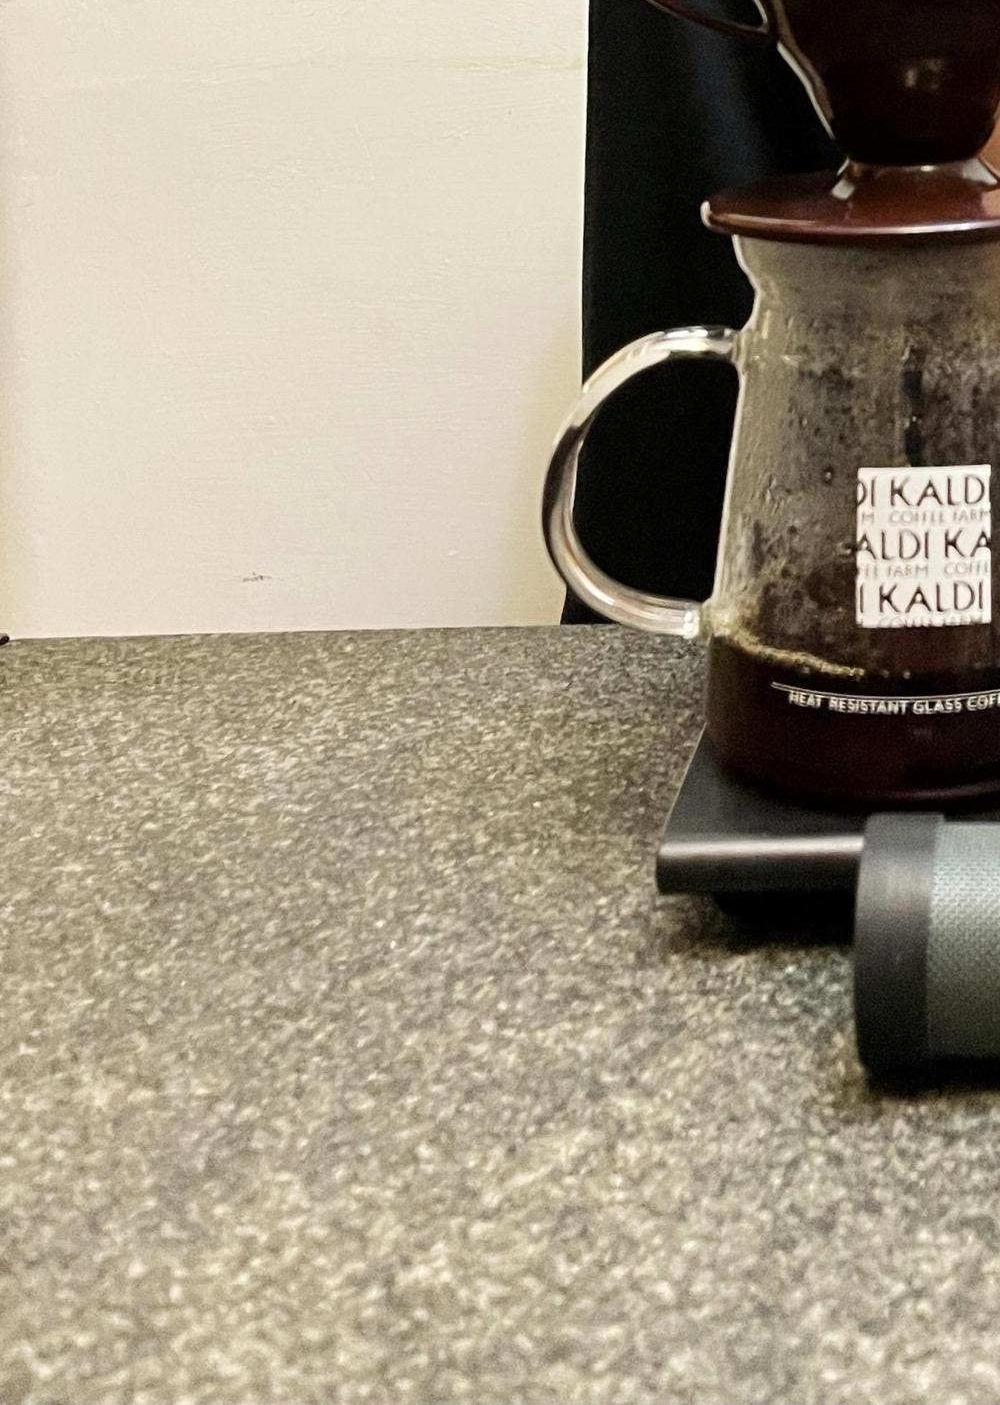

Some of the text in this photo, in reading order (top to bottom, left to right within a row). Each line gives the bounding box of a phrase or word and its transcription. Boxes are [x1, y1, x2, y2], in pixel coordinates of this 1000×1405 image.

[889, 474, 985, 507] KALD
[857, 529, 990, 561] ALDI KA
[877, 580, 984, 614] KALDI
[788, 689, 823, 709] HEAT
[828, 695, 910, 715] RESISTANT
[912, 697, 963, 715] GLASS
